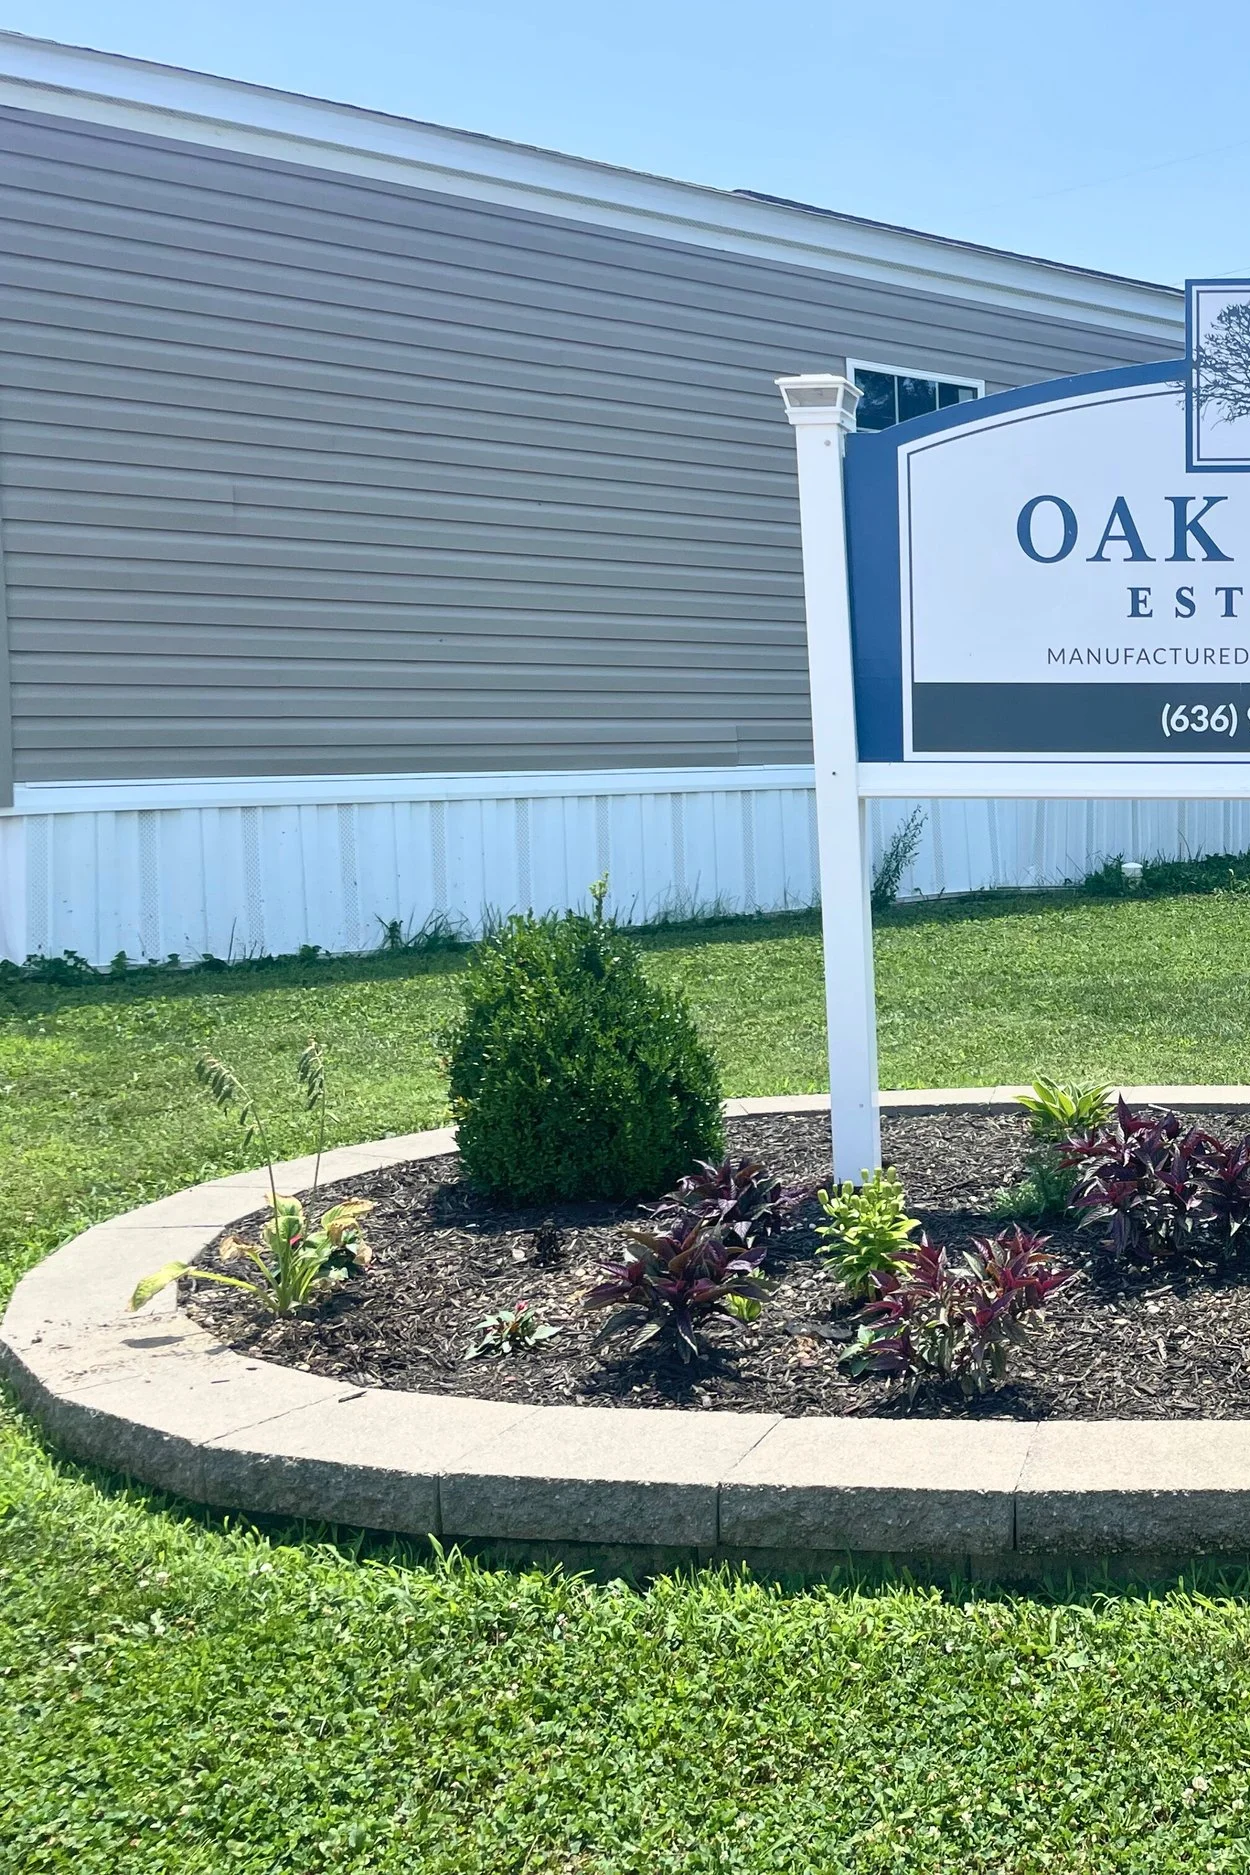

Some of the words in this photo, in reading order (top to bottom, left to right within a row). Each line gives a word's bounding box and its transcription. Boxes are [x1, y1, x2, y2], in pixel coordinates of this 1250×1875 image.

[1016, 495, 1235, 563] OAK
[1047, 647, 1249, 665] MANUFACTURED
[1160, 702, 1238, 737] (636)
